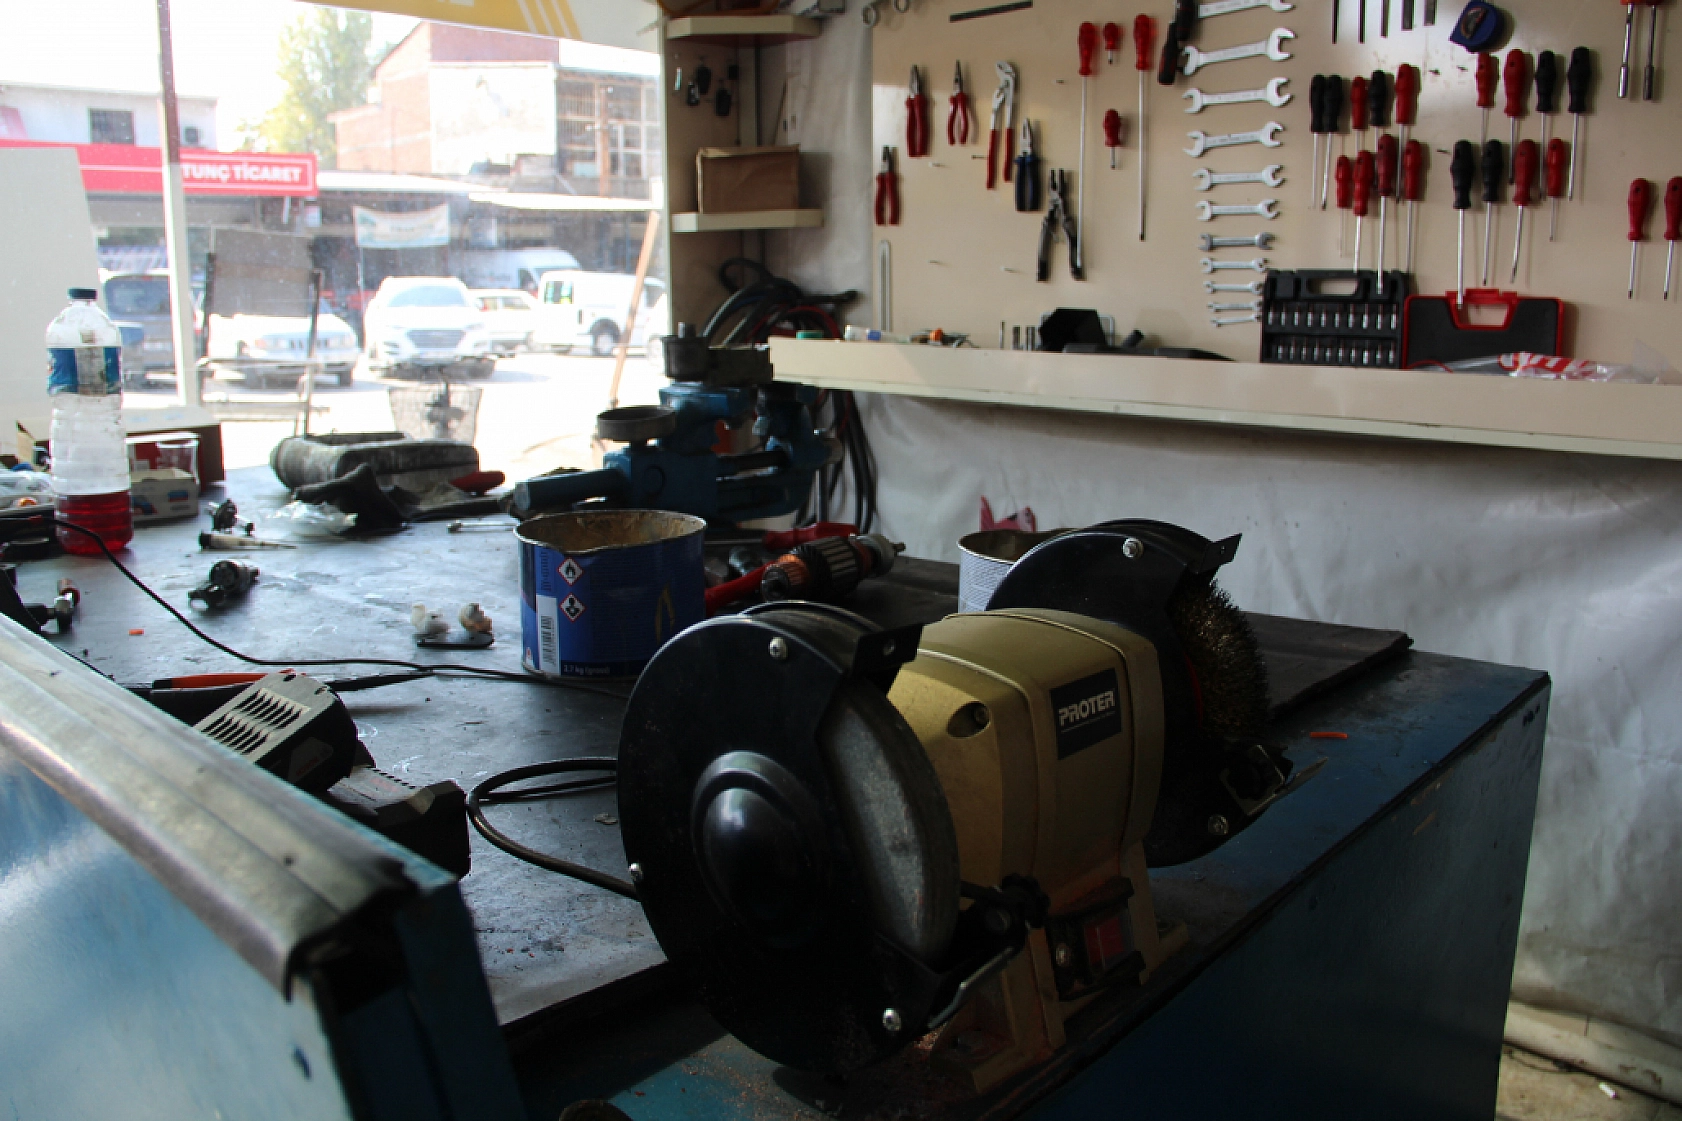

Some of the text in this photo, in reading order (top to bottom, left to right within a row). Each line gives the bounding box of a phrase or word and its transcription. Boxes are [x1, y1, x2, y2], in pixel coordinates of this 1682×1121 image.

[182, 163, 301, 182] TUNÇ TİCARET
[1058, 690, 1116, 727] PROTER
